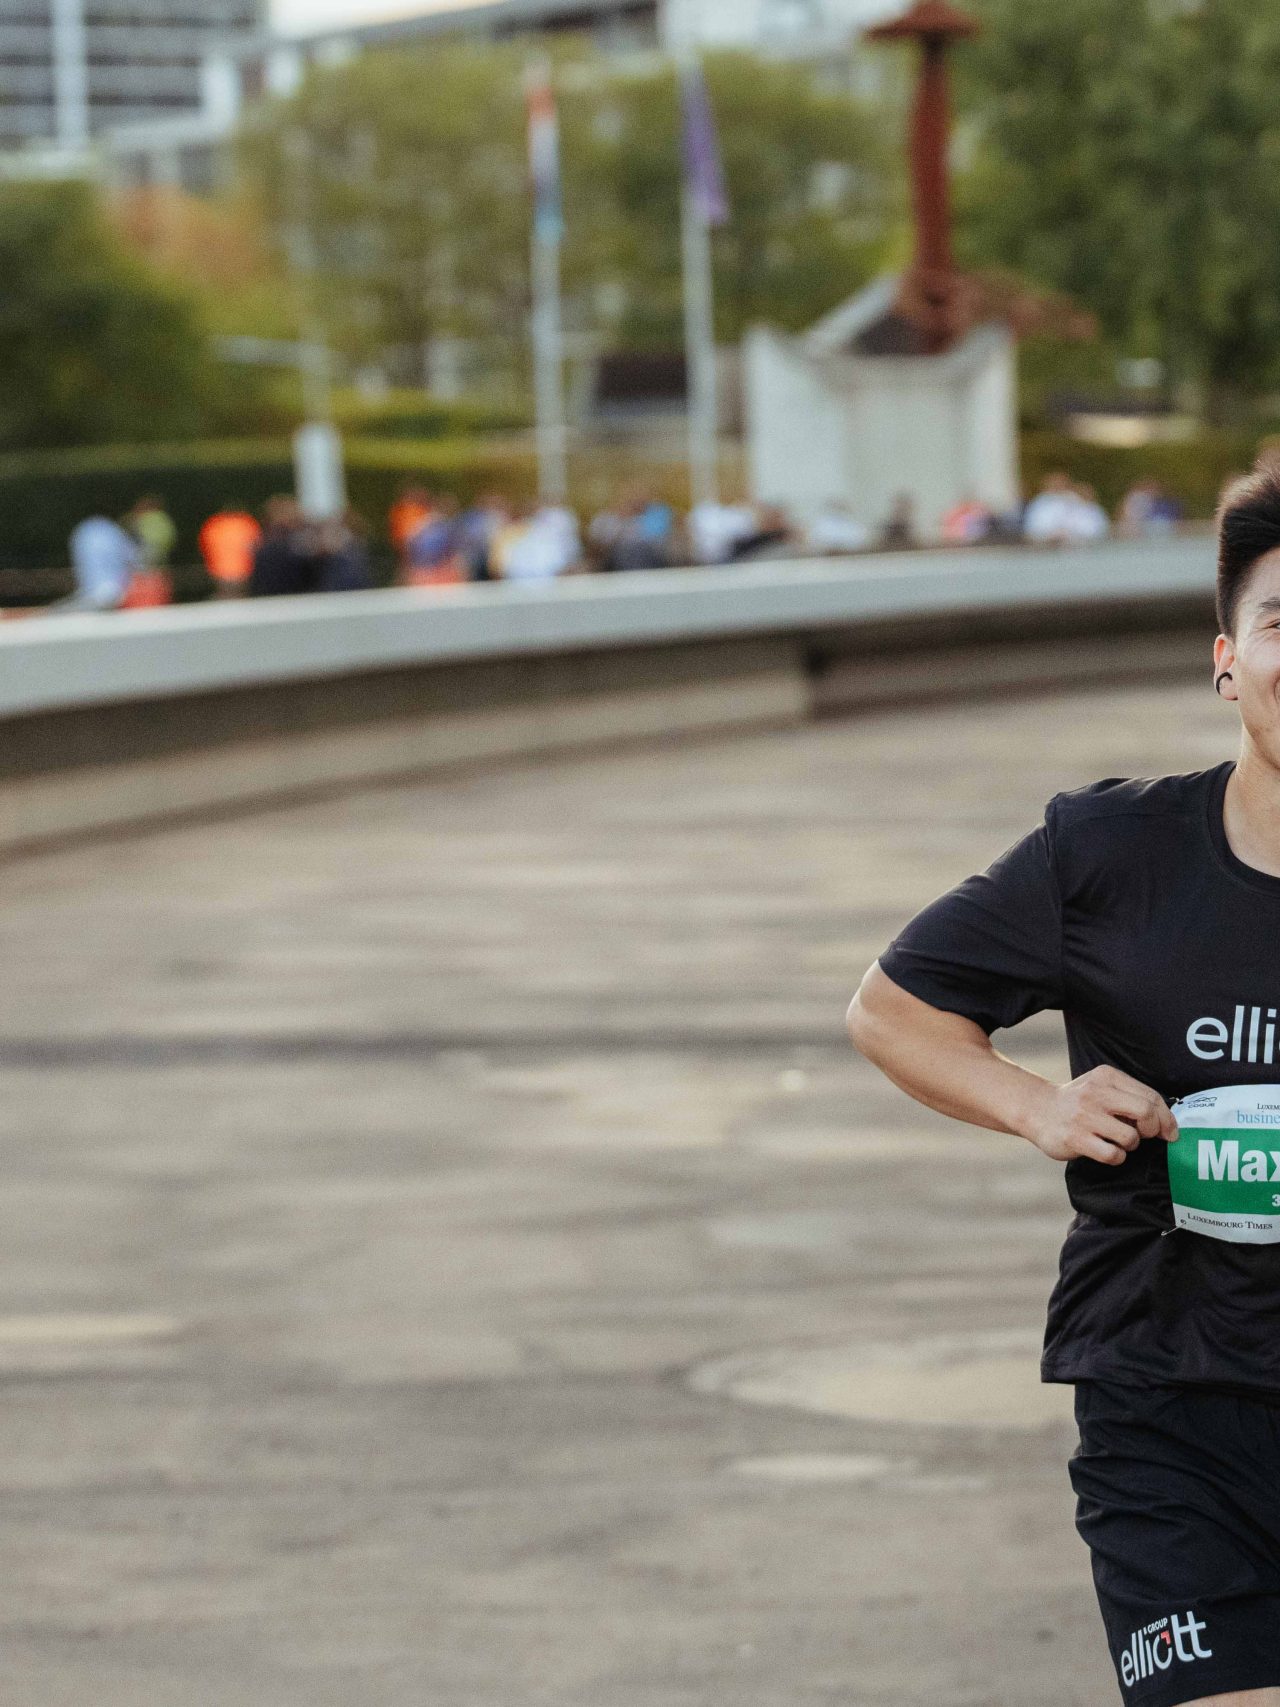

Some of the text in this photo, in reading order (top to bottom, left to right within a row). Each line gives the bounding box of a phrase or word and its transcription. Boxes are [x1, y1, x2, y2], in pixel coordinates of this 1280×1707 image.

[1187, 1212, 1273, 1230] LUXEMBOURG TIMES
[1147, 1617, 1168, 1633] GROUP
[1120, 1611, 1213, 1688] elliott
